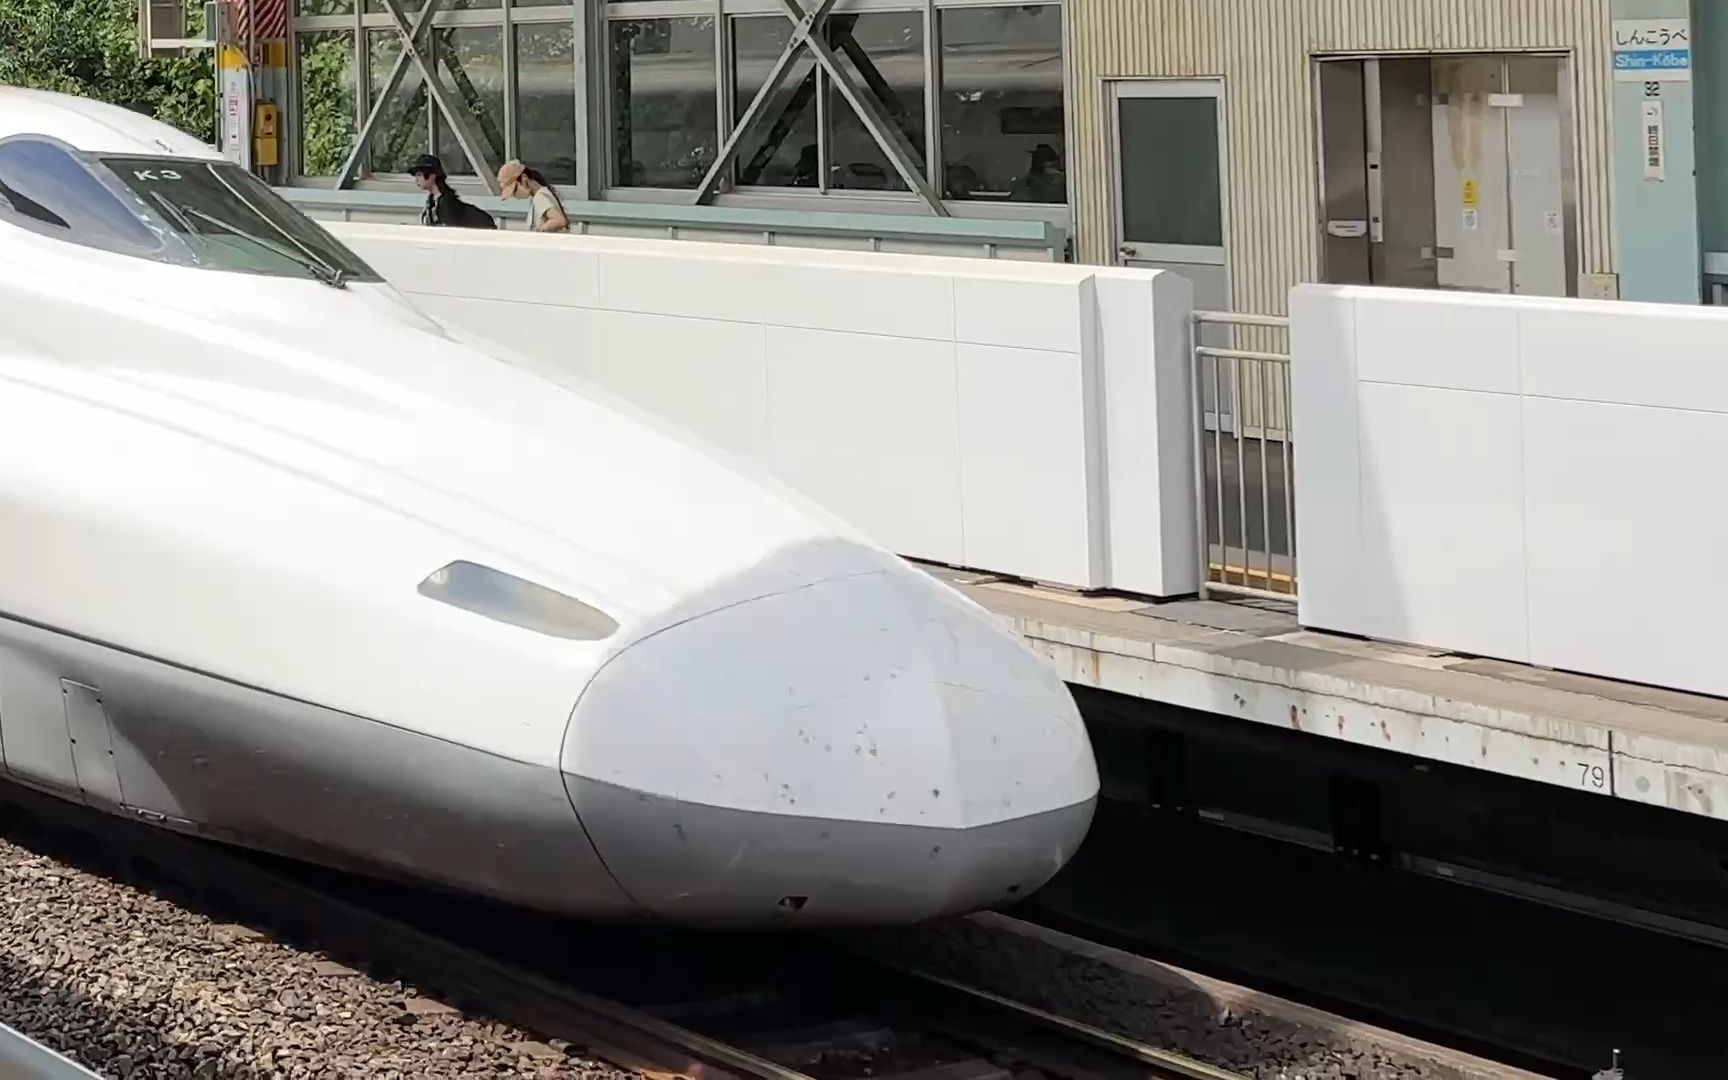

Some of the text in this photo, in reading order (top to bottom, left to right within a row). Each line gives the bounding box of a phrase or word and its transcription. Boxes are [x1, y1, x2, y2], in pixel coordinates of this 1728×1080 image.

[1616, 28, 1688, 46] しんこうべ
[1577, 762, 1605, 788] 79
